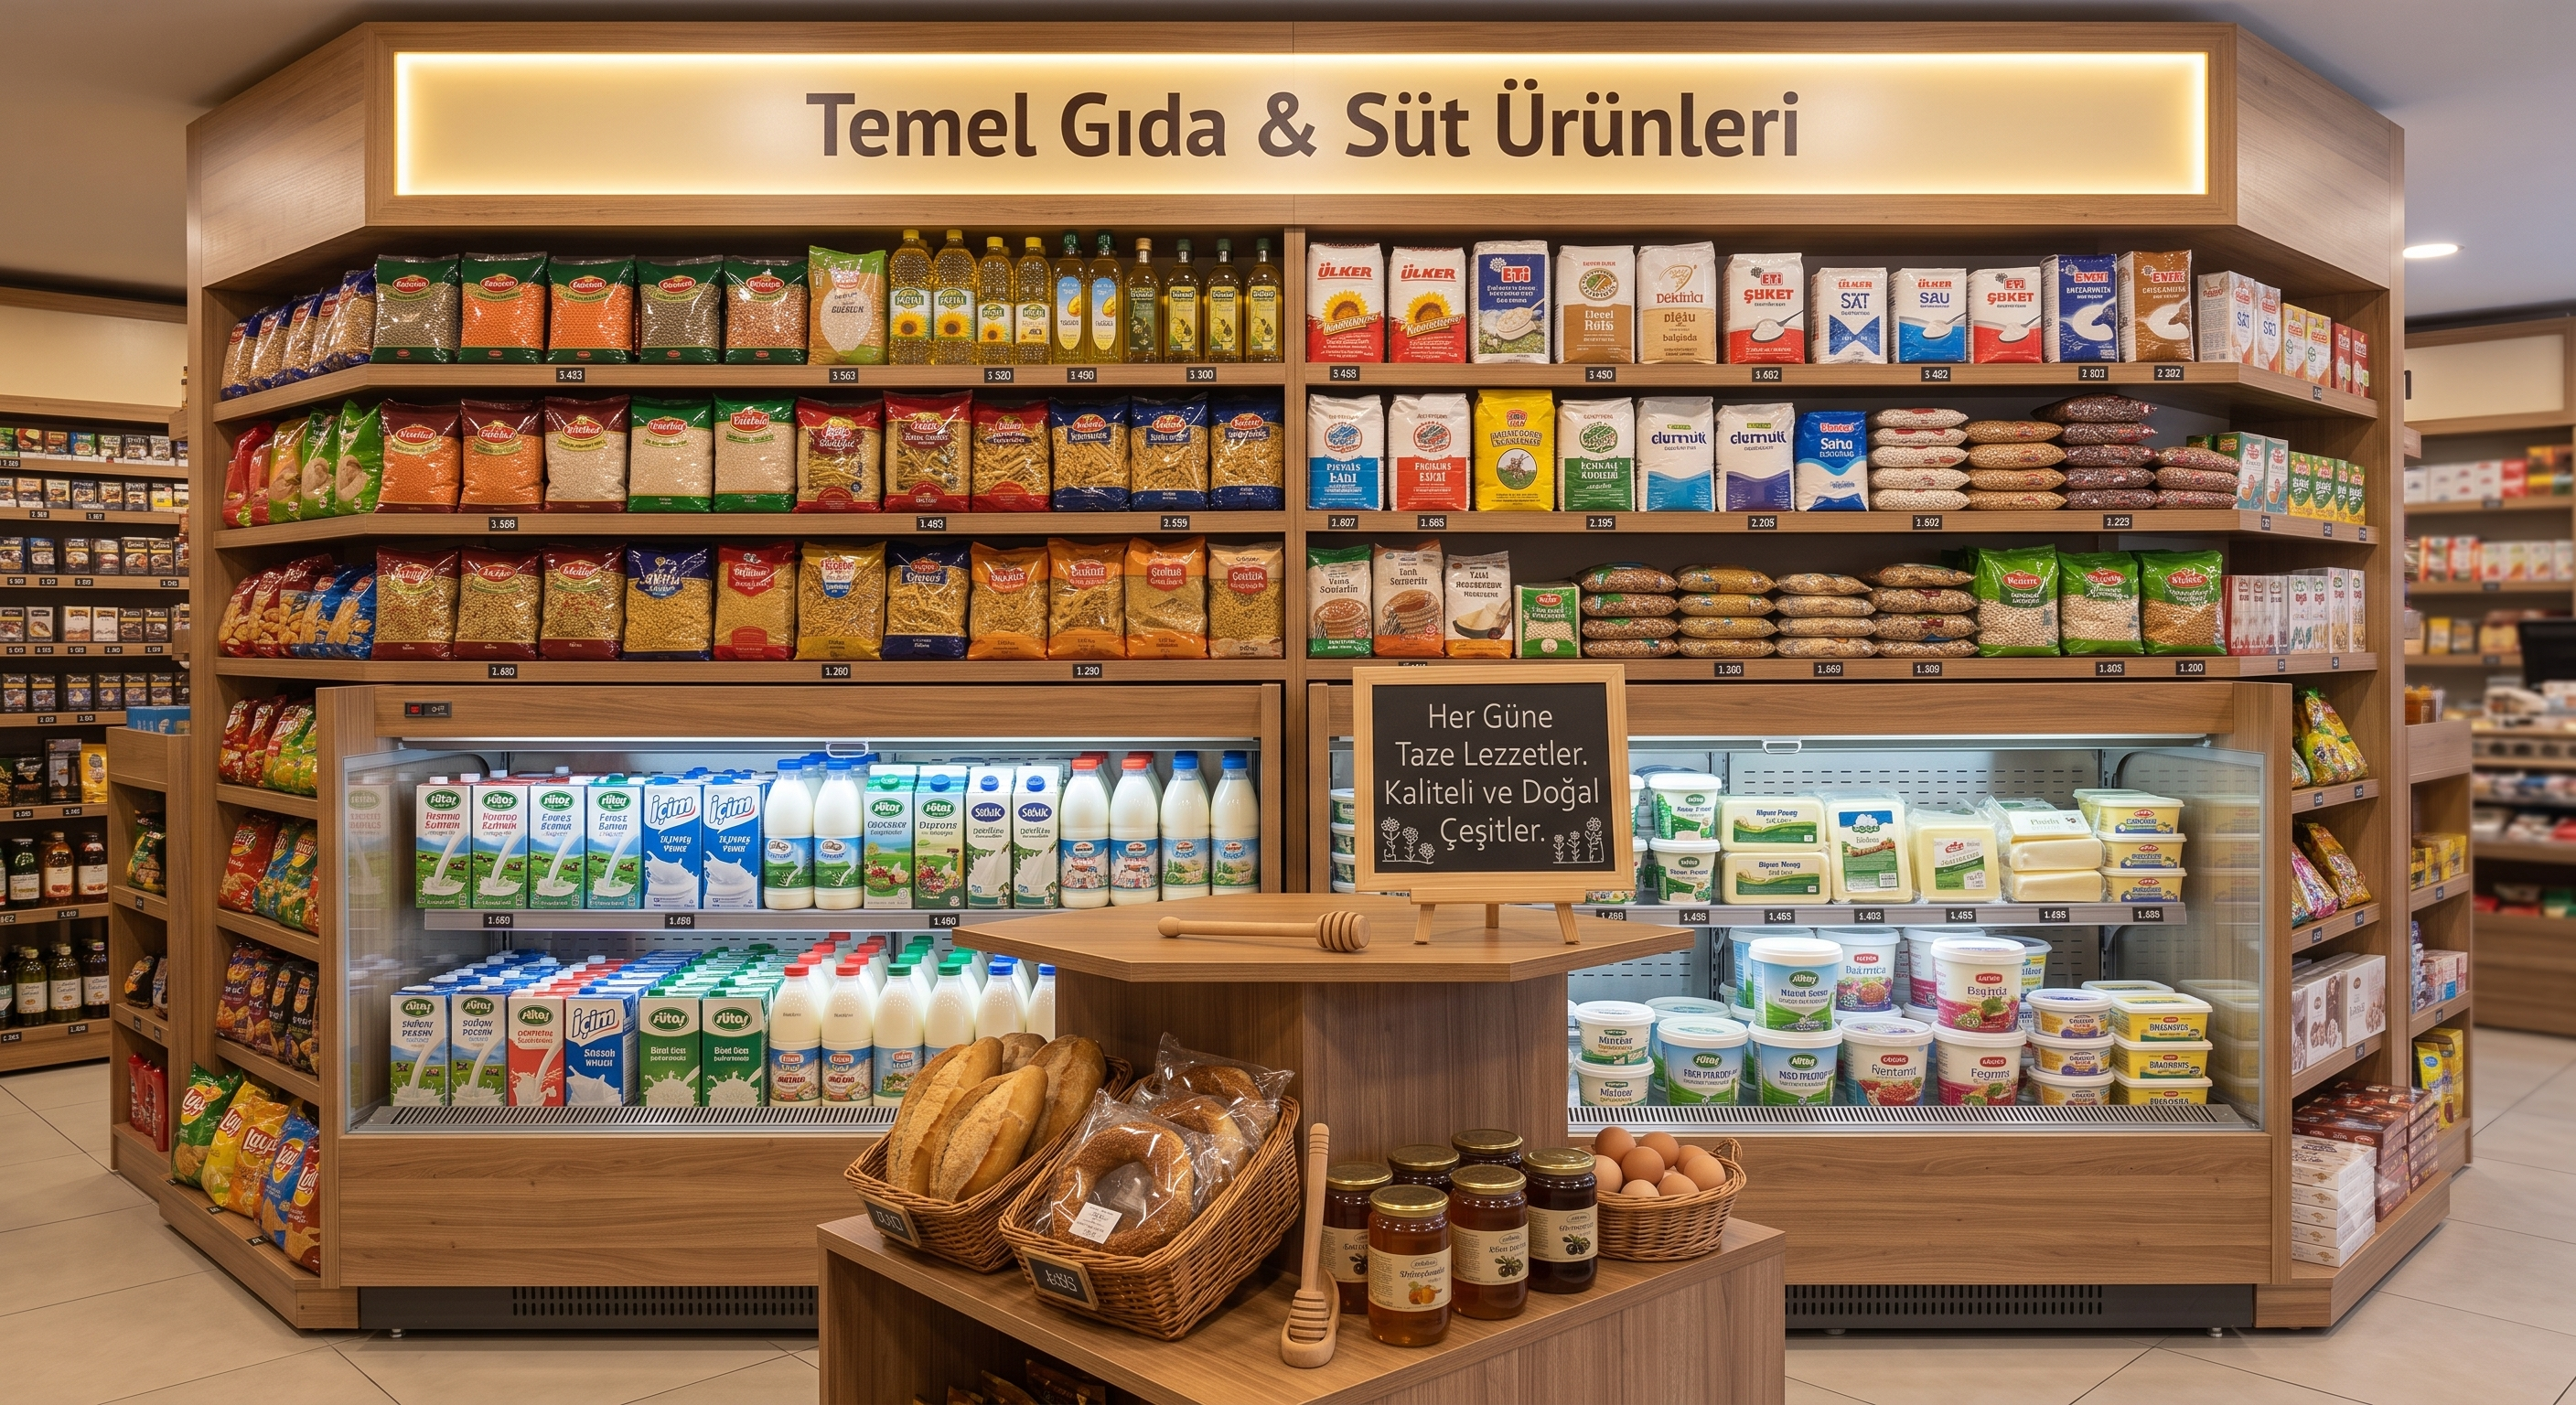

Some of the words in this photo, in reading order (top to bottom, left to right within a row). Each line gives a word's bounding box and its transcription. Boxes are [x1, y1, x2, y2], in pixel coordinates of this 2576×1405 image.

[806, 91, 1036, 158] Temel
[1060, 91, 1228, 158] Gıda
[1256, 91, 1317, 158] &
[1344, 91, 1470, 158] Süt
[1494, 79, 1799, 158] Ürünleri
[1317, 262, 1373, 278] ÜLKER
[1401, 263, 1456, 280] ÜLKER
[1590, 519, 1613, 527] 2.195
[825, 667, 848, 676] 1.260
[2180, 663, 2203, 672] 1.200
[1429, 703, 1476, 728] Her
[1483, 702, 1553, 729] Güne
[1394, 741, 1455, 767] Taze
[1464, 739, 1588, 767] Lezzetler.
[1385, 778, 1474, 805] Kaliteli
[1482, 786, 1512, 804] ve
[1522, 778, 1599, 812] Doğal
[1440, 816, 1546, 851] Çeşitler.
